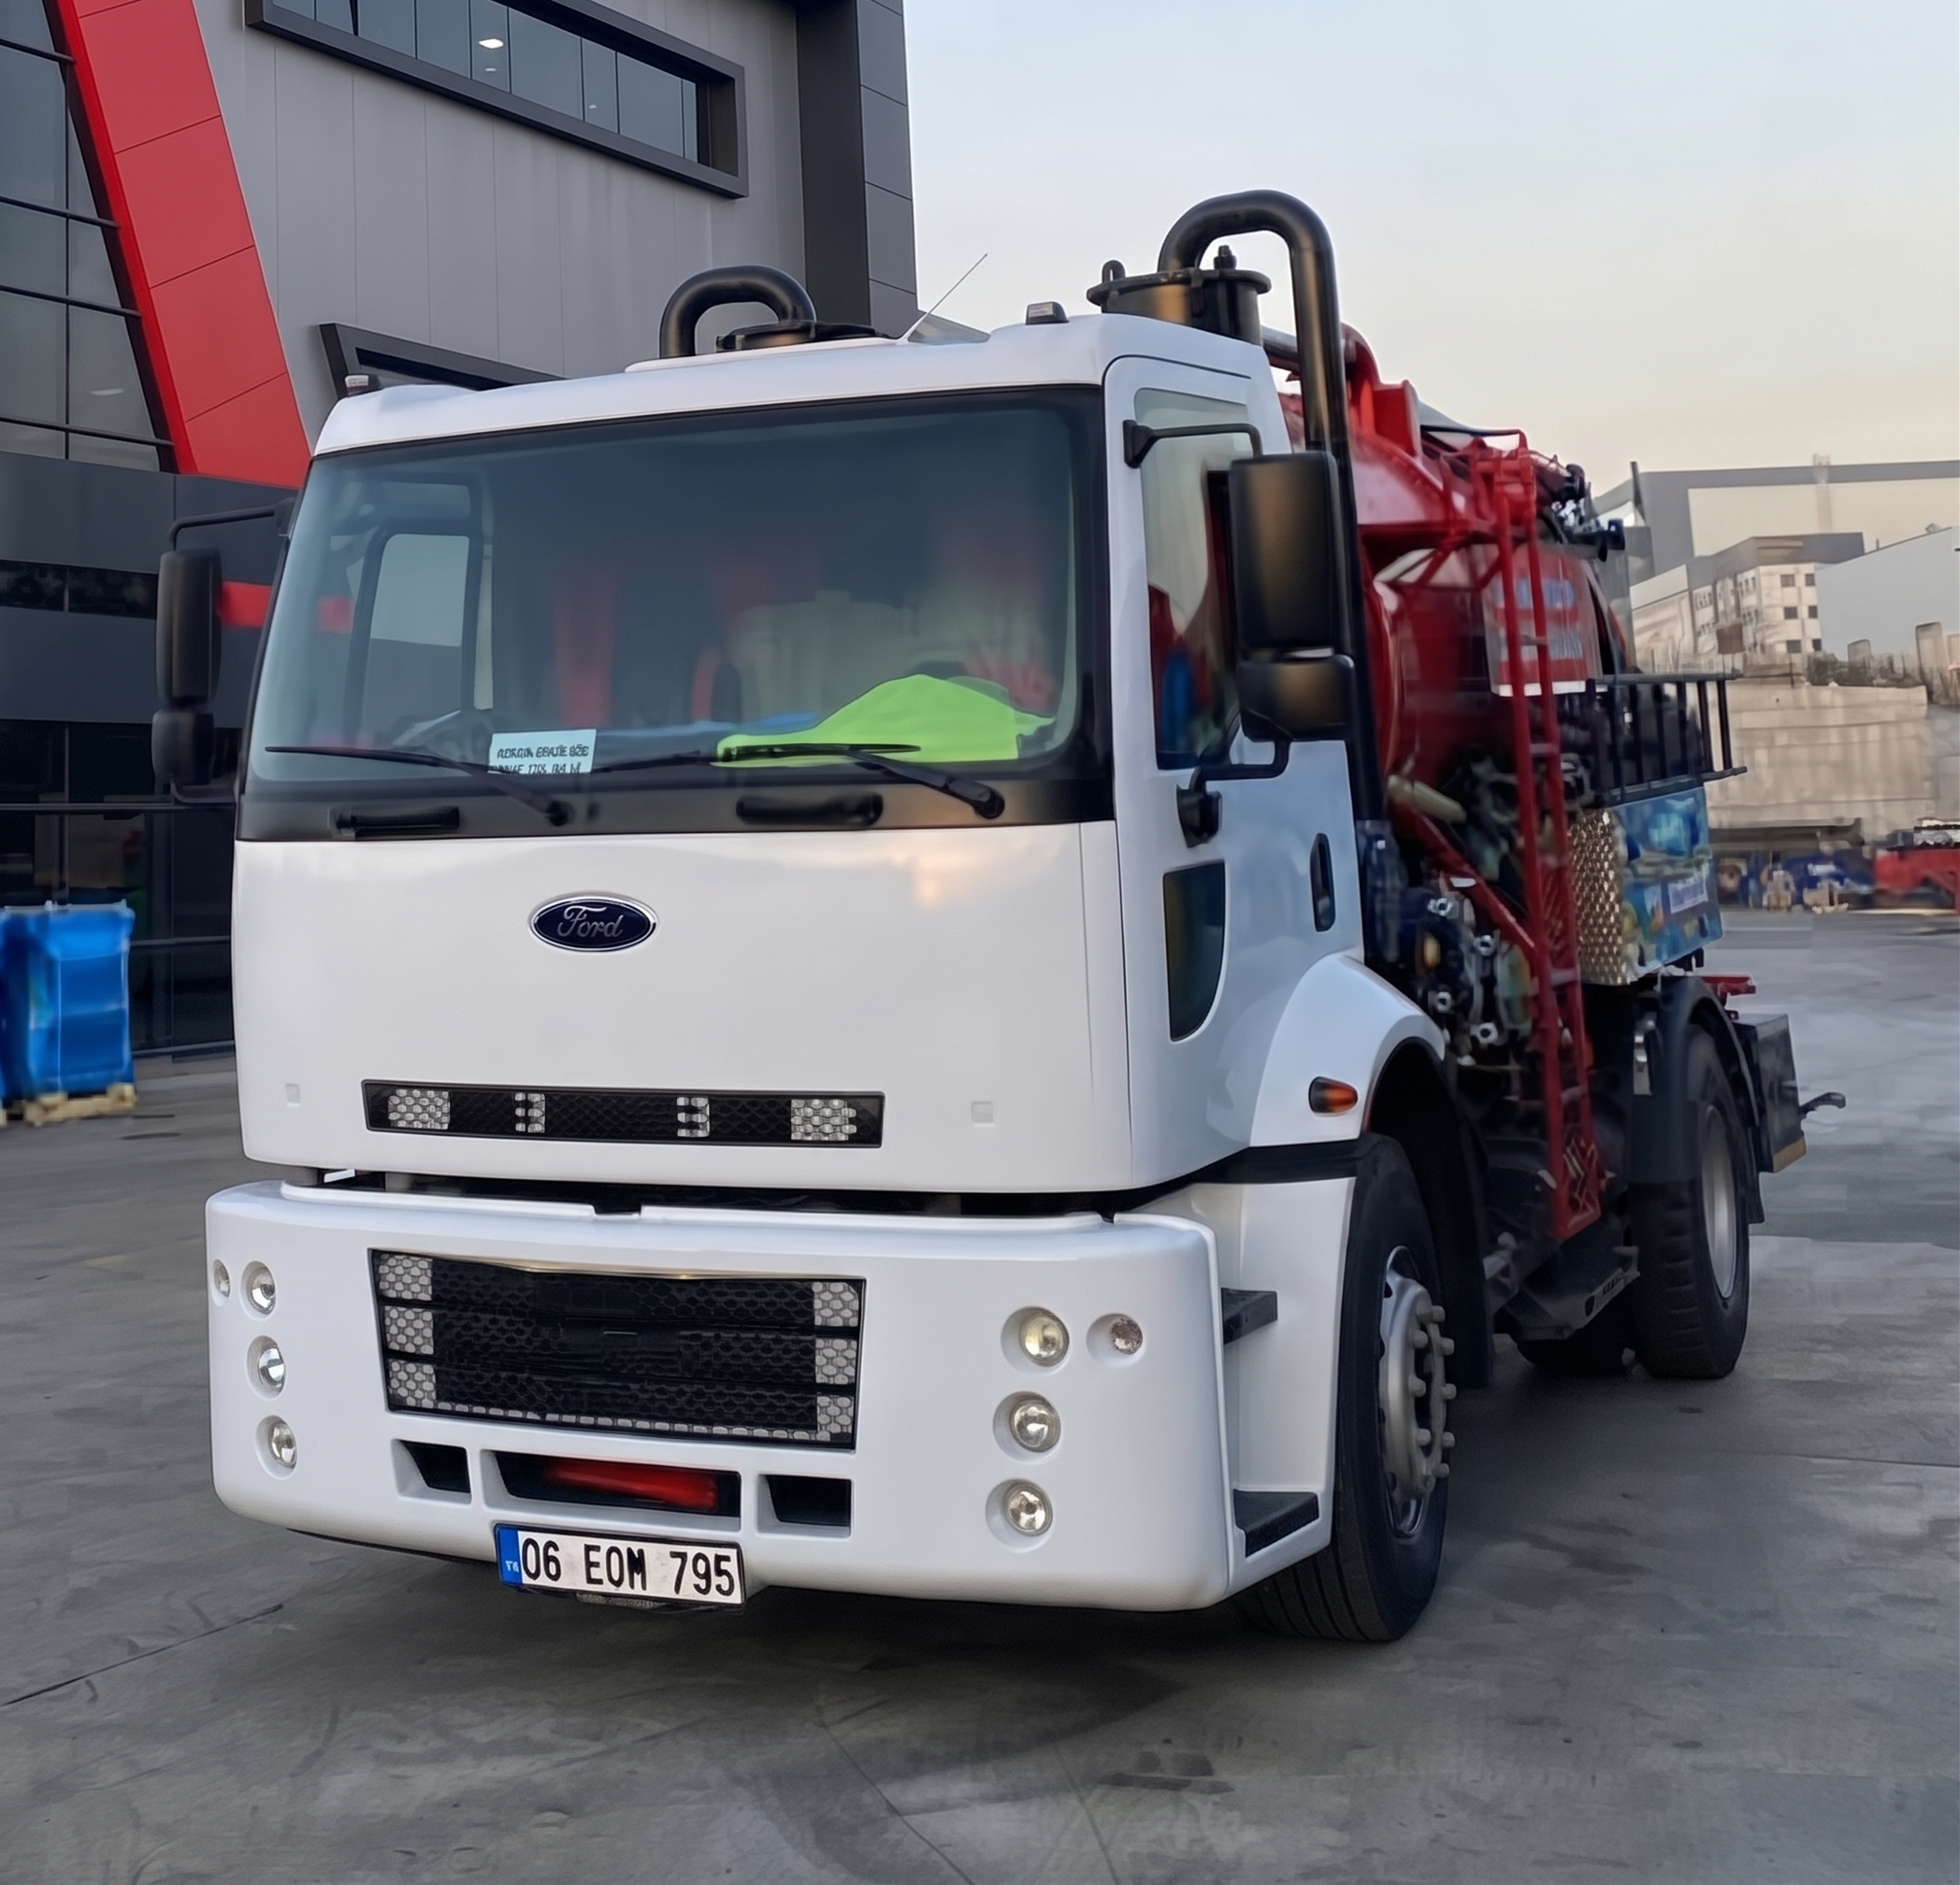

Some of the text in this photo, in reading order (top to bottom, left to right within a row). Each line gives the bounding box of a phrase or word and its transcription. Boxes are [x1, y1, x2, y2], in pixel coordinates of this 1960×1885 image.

[556, 905, 625, 938] Ford
[522, 1537, 735, 1596] 06 EOM 795
